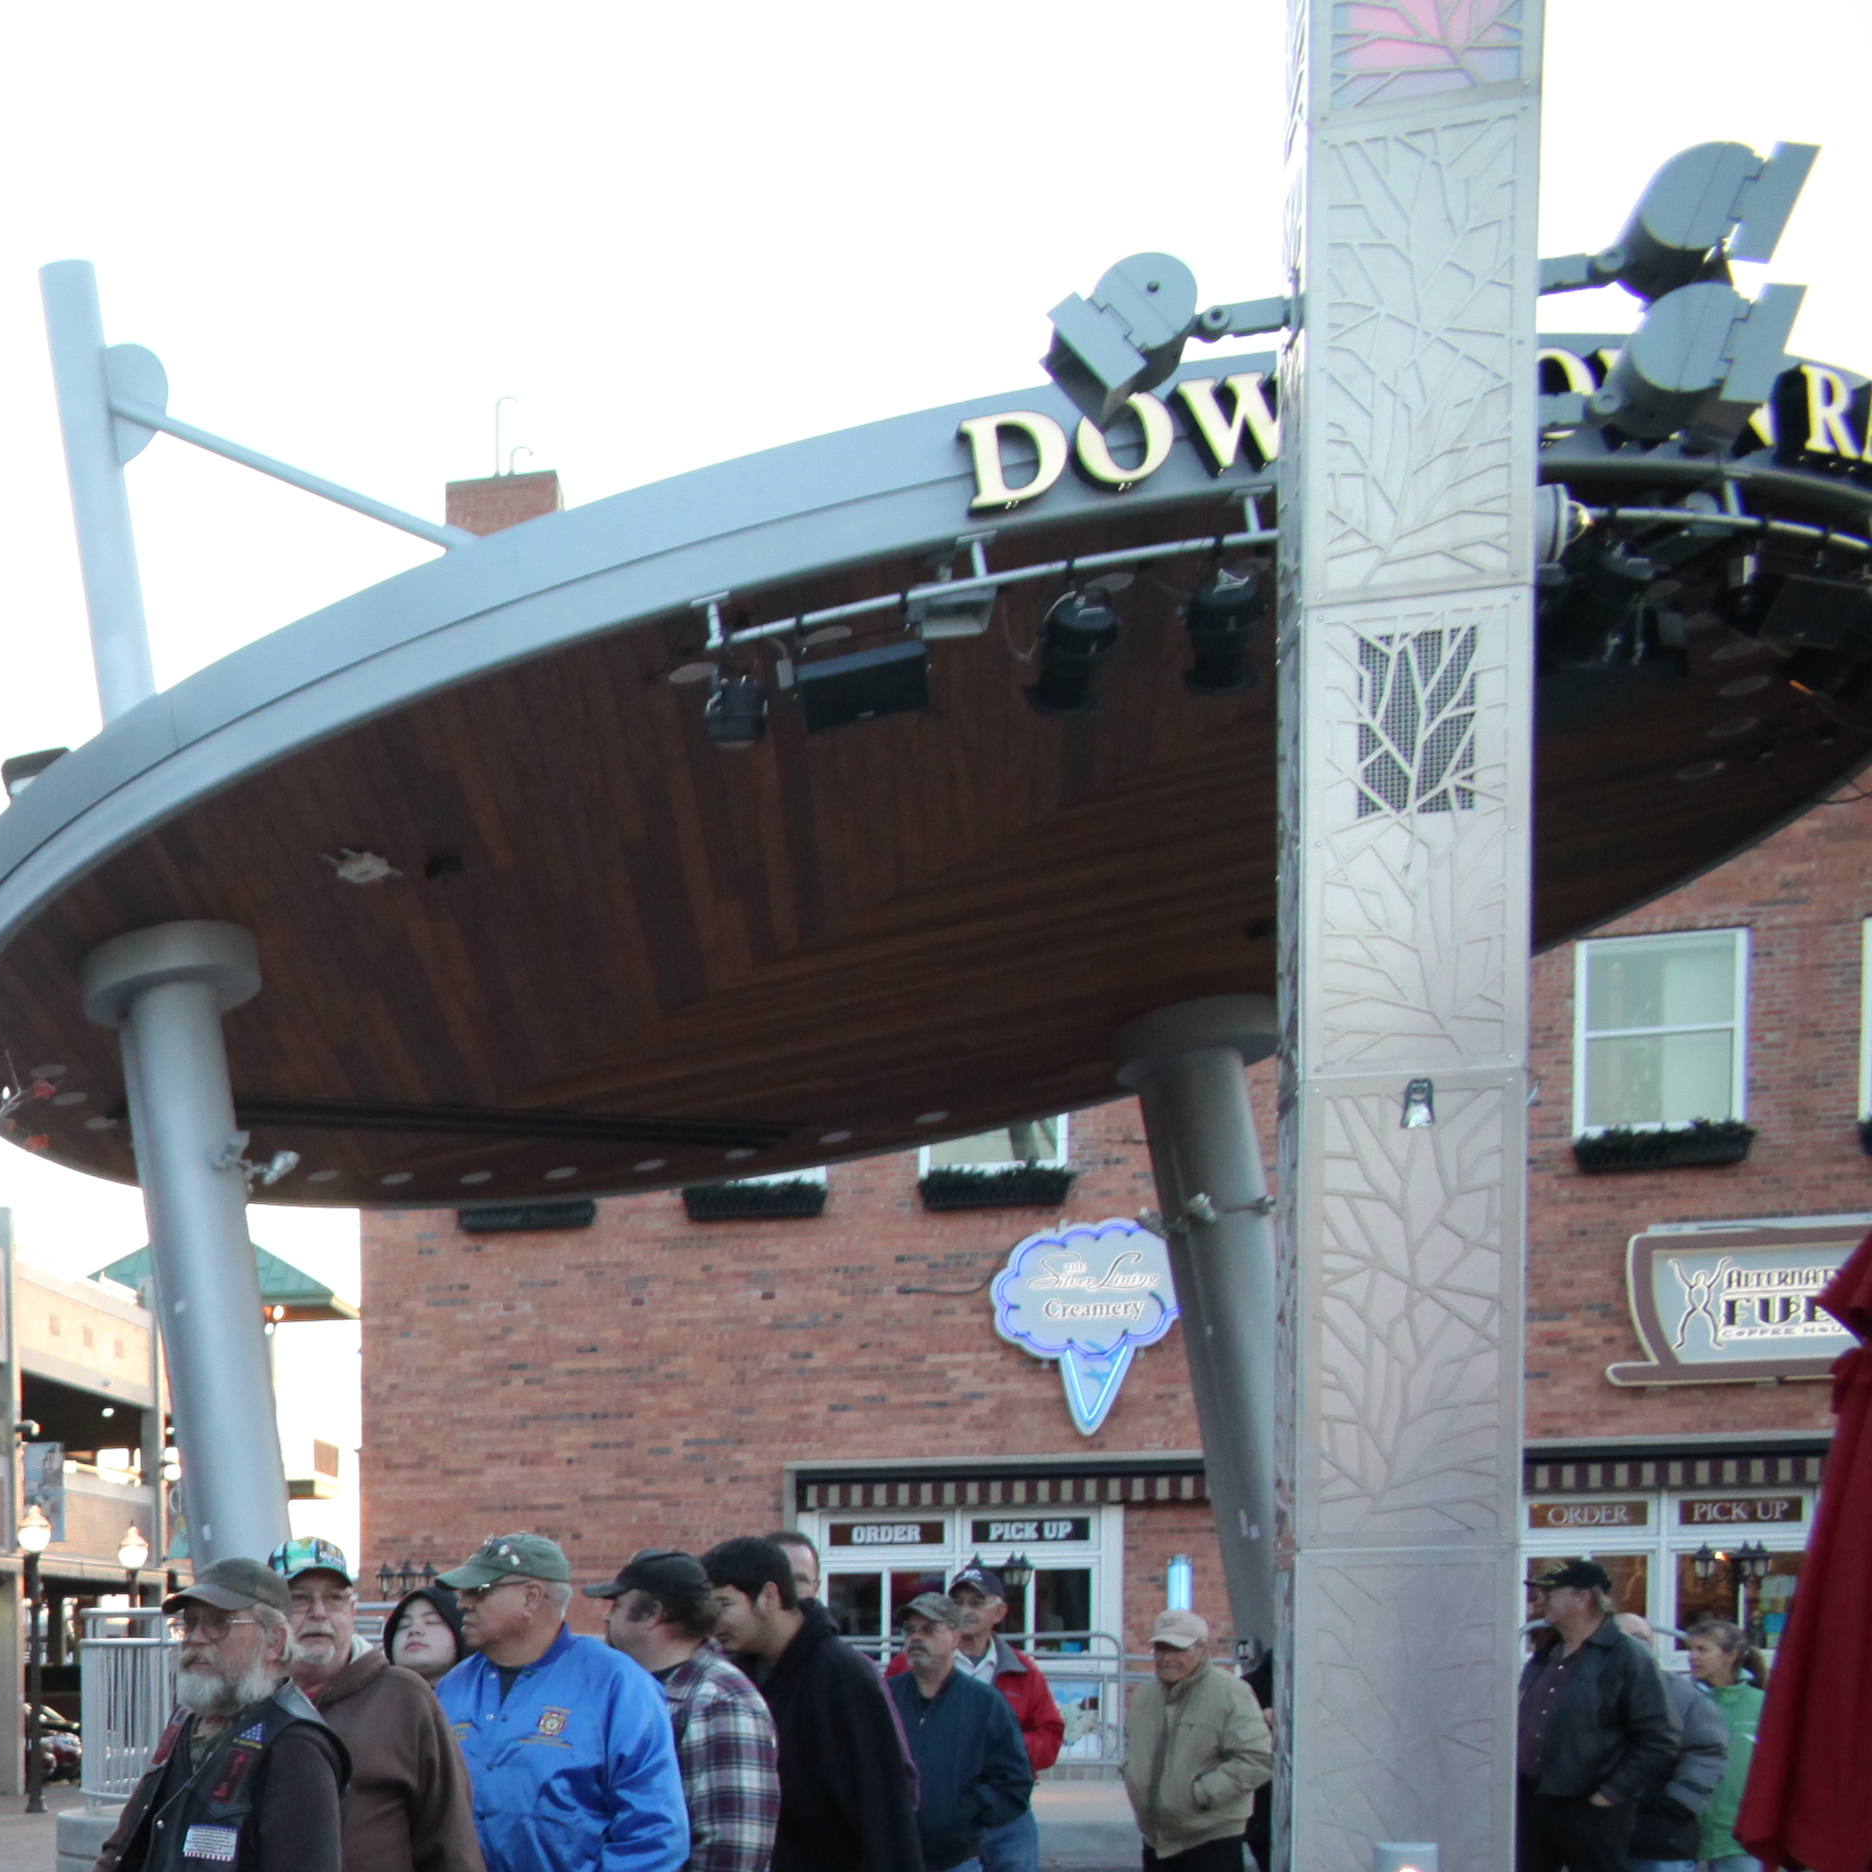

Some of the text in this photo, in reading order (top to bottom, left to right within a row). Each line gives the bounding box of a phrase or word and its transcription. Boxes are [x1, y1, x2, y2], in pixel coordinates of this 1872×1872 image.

[1027, 1250, 1159, 1291] Silver Lining
[1724, 1267, 1834, 1290] ALTERNAT
[1044, 1298, 1145, 1320] Creamery
[1722, 1296, 1832, 1327] FUE
[1722, 1324, 1843, 1338] COFFEE HOU
[1547, 1504, 1628, 1525] ORDER
[1692, 1501, 1788, 1522] PICK UP
[851, 1524, 922, 1545] ORDER
[988, 1520, 1073, 1542] PICK UP
